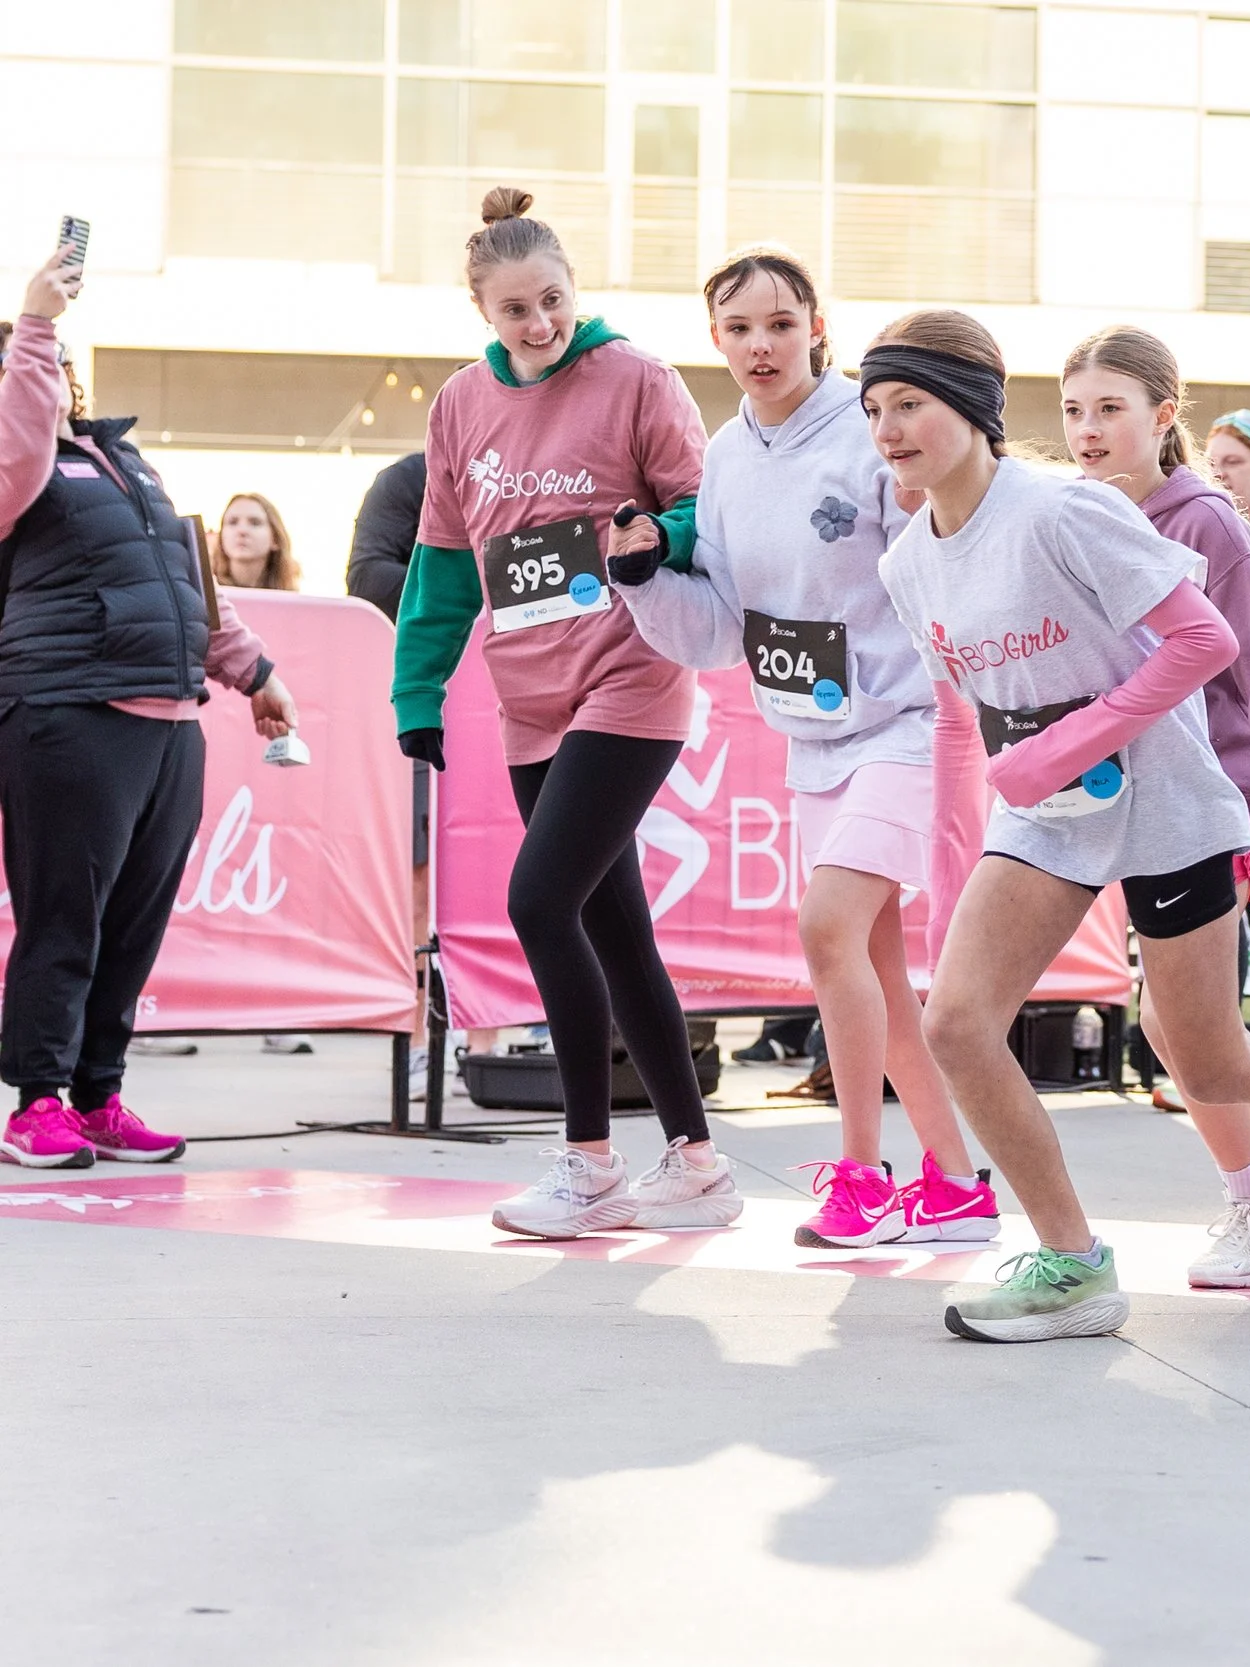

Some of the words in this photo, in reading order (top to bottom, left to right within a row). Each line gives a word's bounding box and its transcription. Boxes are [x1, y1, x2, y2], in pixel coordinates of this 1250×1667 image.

[501, 469, 597, 498] BIOGirls
[507, 553, 565, 595] 395
[757, 644, 817, 685] 204
[958, 617, 1069, 672] BIOGirls
